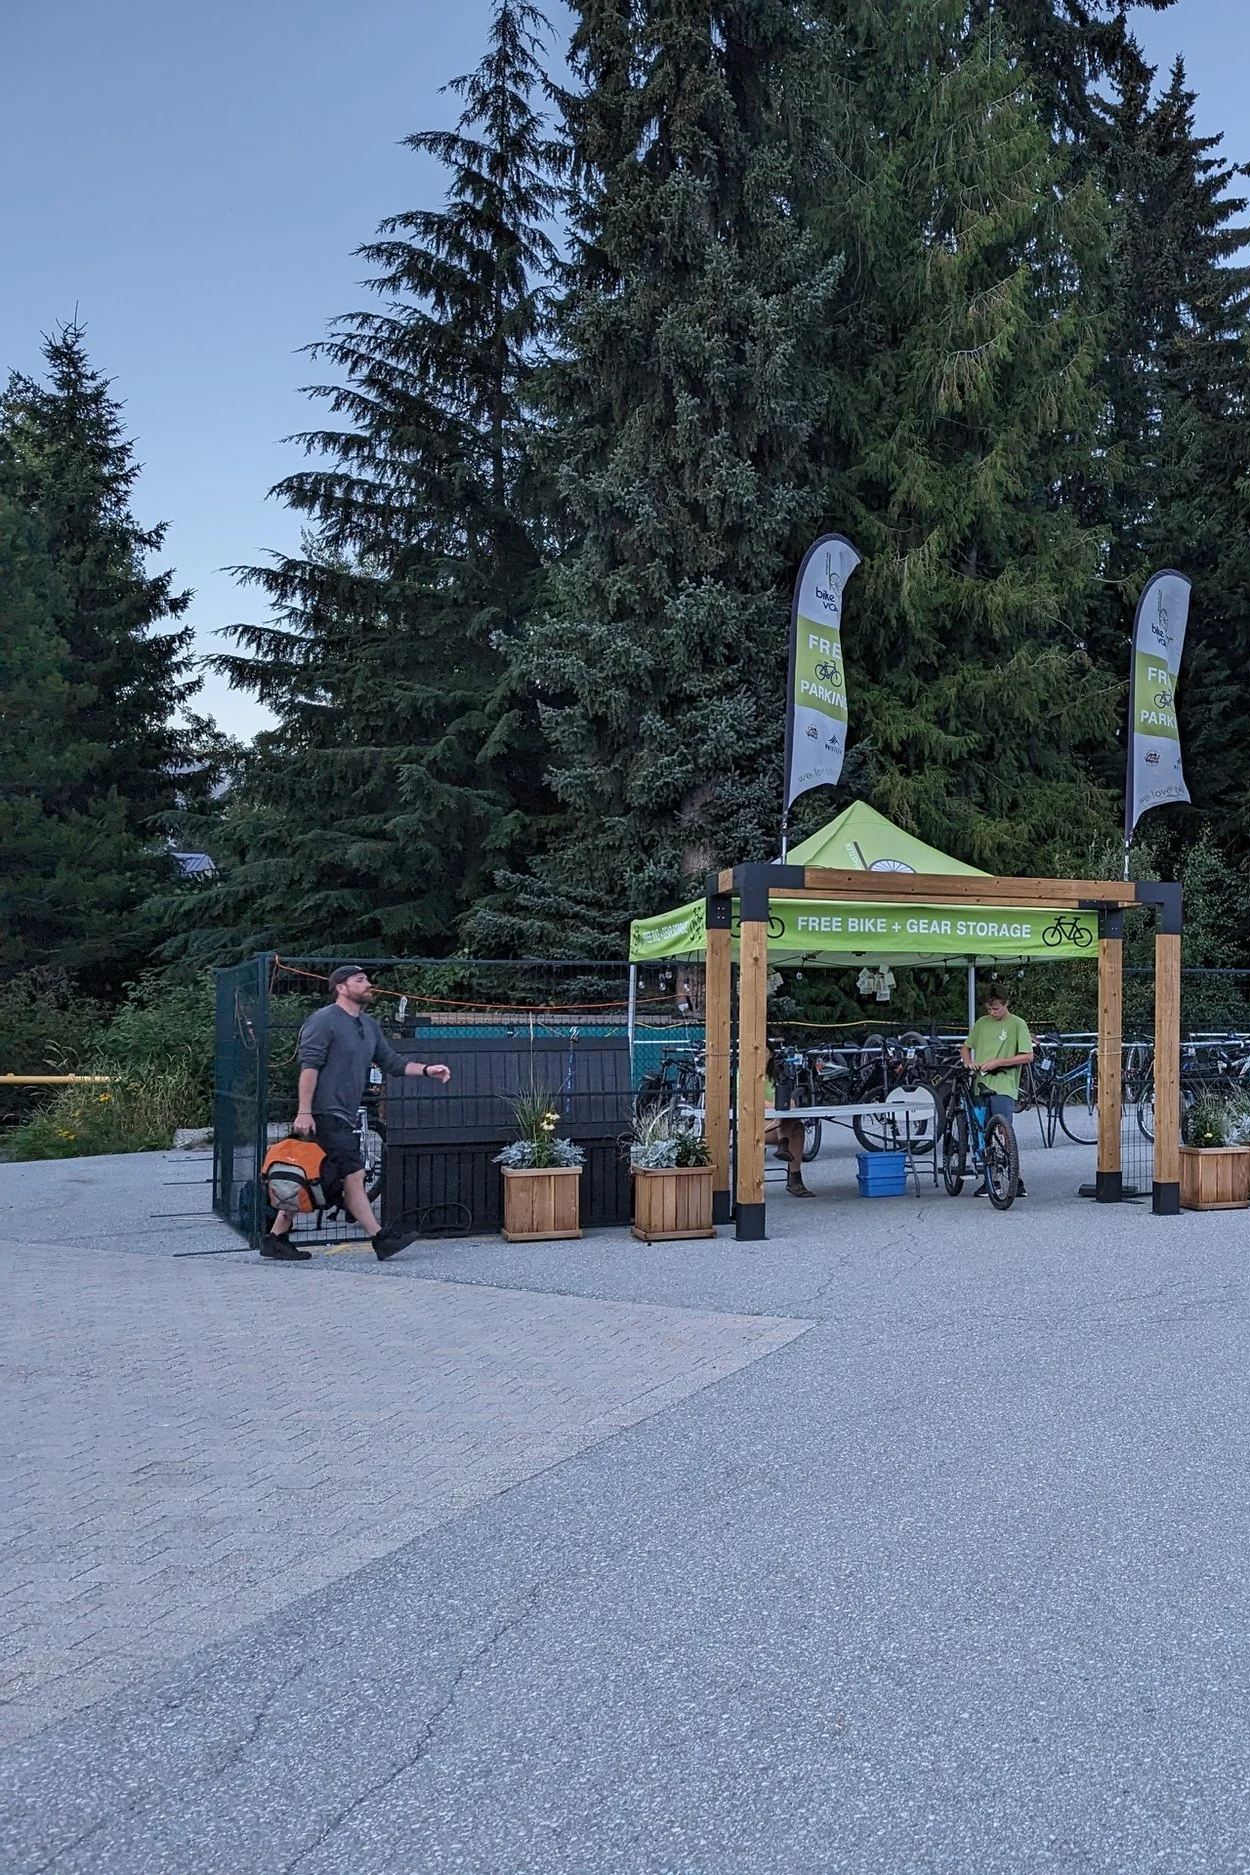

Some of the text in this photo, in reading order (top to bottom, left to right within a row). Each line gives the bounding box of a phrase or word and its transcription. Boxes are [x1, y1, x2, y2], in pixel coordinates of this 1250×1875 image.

[815, 586, 835, 602] bike
[808, 633, 842, 659] FRE
[1140, 709, 1176, 729] PARK
[797, 916, 1032, 938] FREE BIKE + GEAR STORAGE
